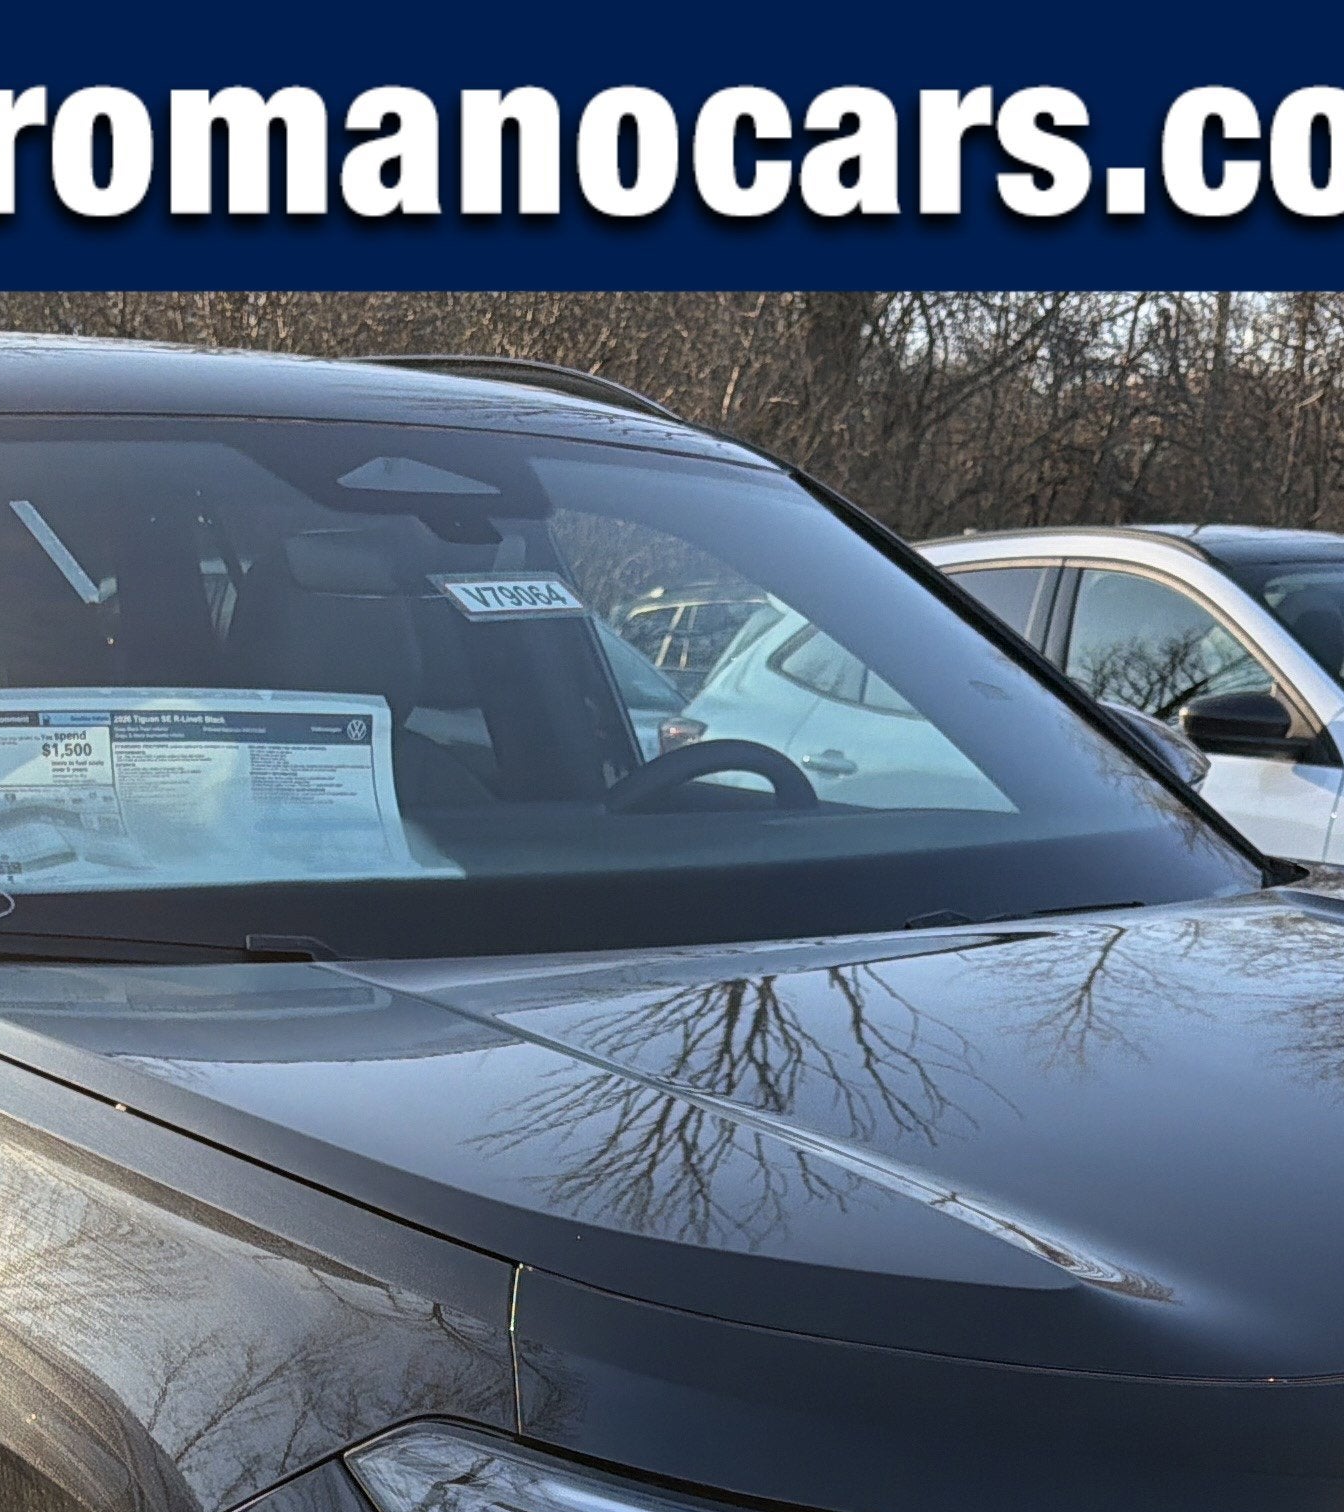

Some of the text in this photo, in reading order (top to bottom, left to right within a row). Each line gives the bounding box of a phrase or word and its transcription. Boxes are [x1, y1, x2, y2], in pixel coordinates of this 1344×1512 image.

[461, 584, 567, 608] V79064
[54, 730, 87, 743] spend
[42, 742, 93, 759] $1,500
